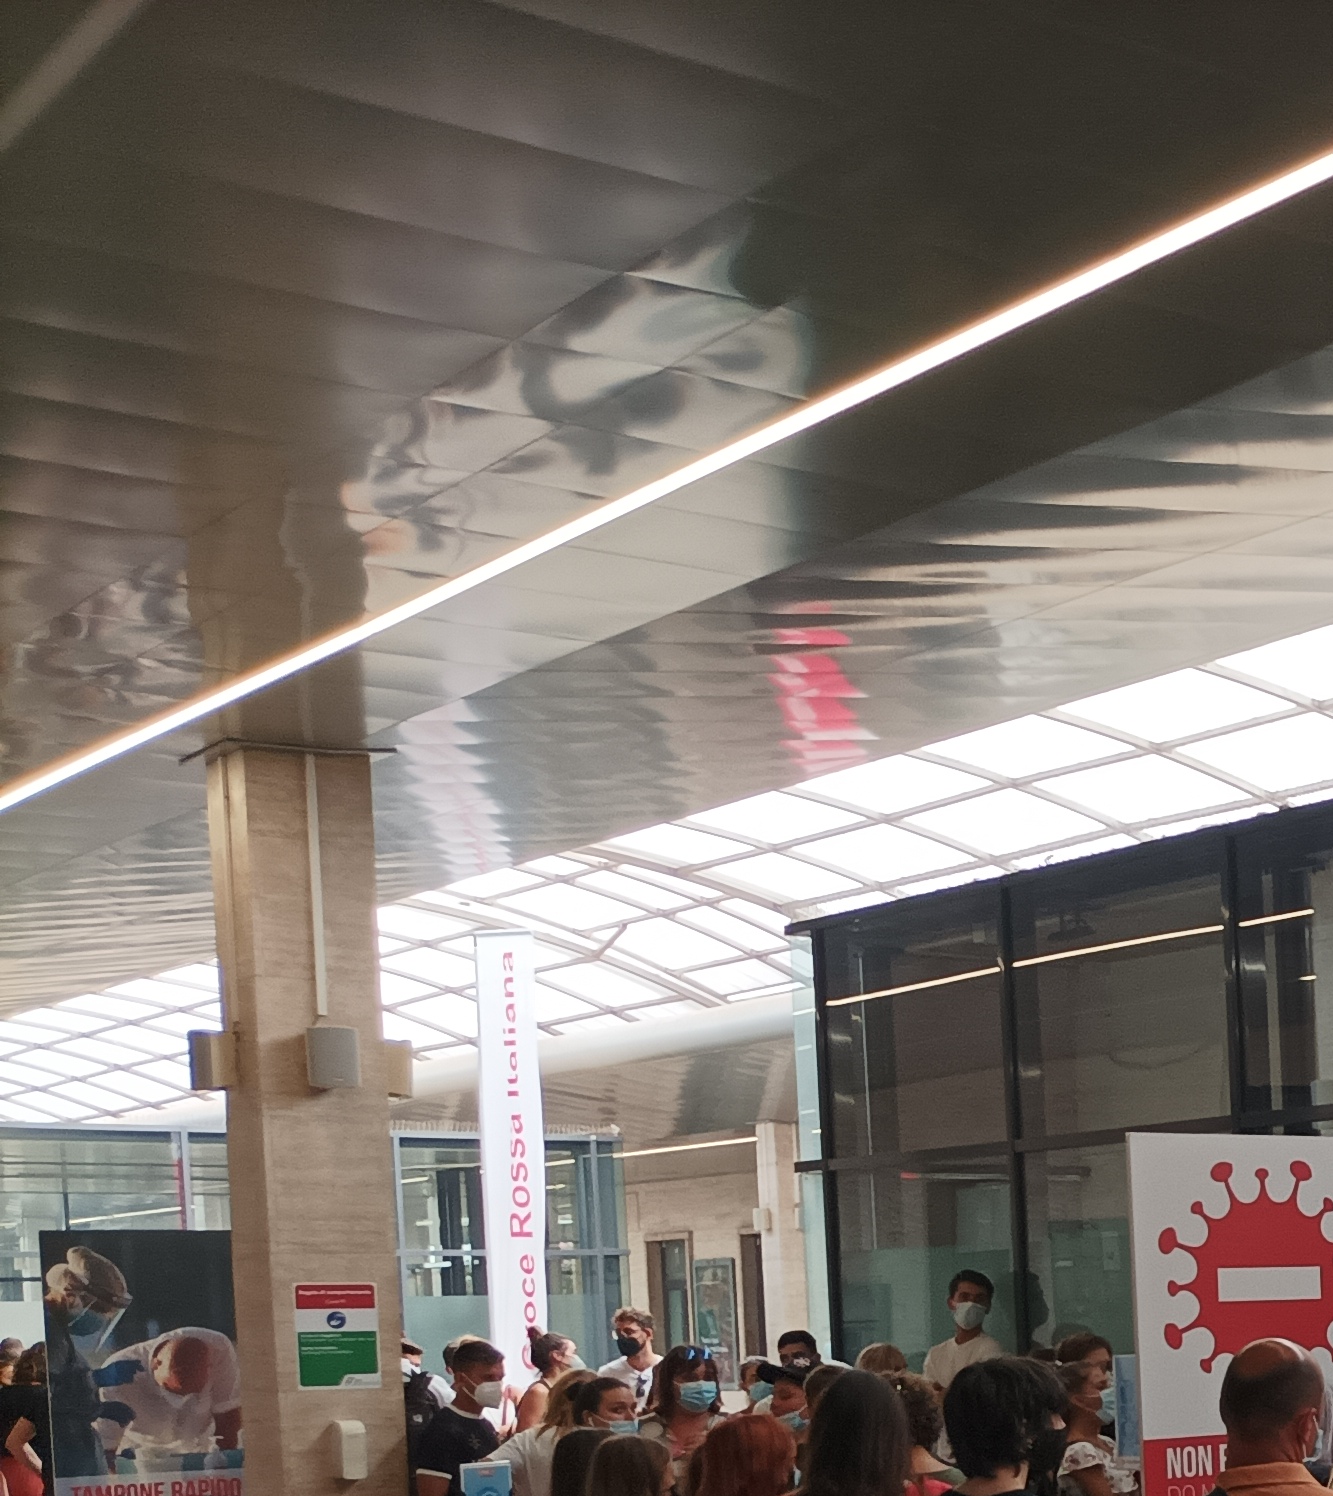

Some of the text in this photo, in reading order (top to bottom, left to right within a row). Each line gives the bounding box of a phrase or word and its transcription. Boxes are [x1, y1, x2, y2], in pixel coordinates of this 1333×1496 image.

[502, 951, 537, 1370] Coce Rossa Italiana
[1166, 1444, 1213, 1480] NON
